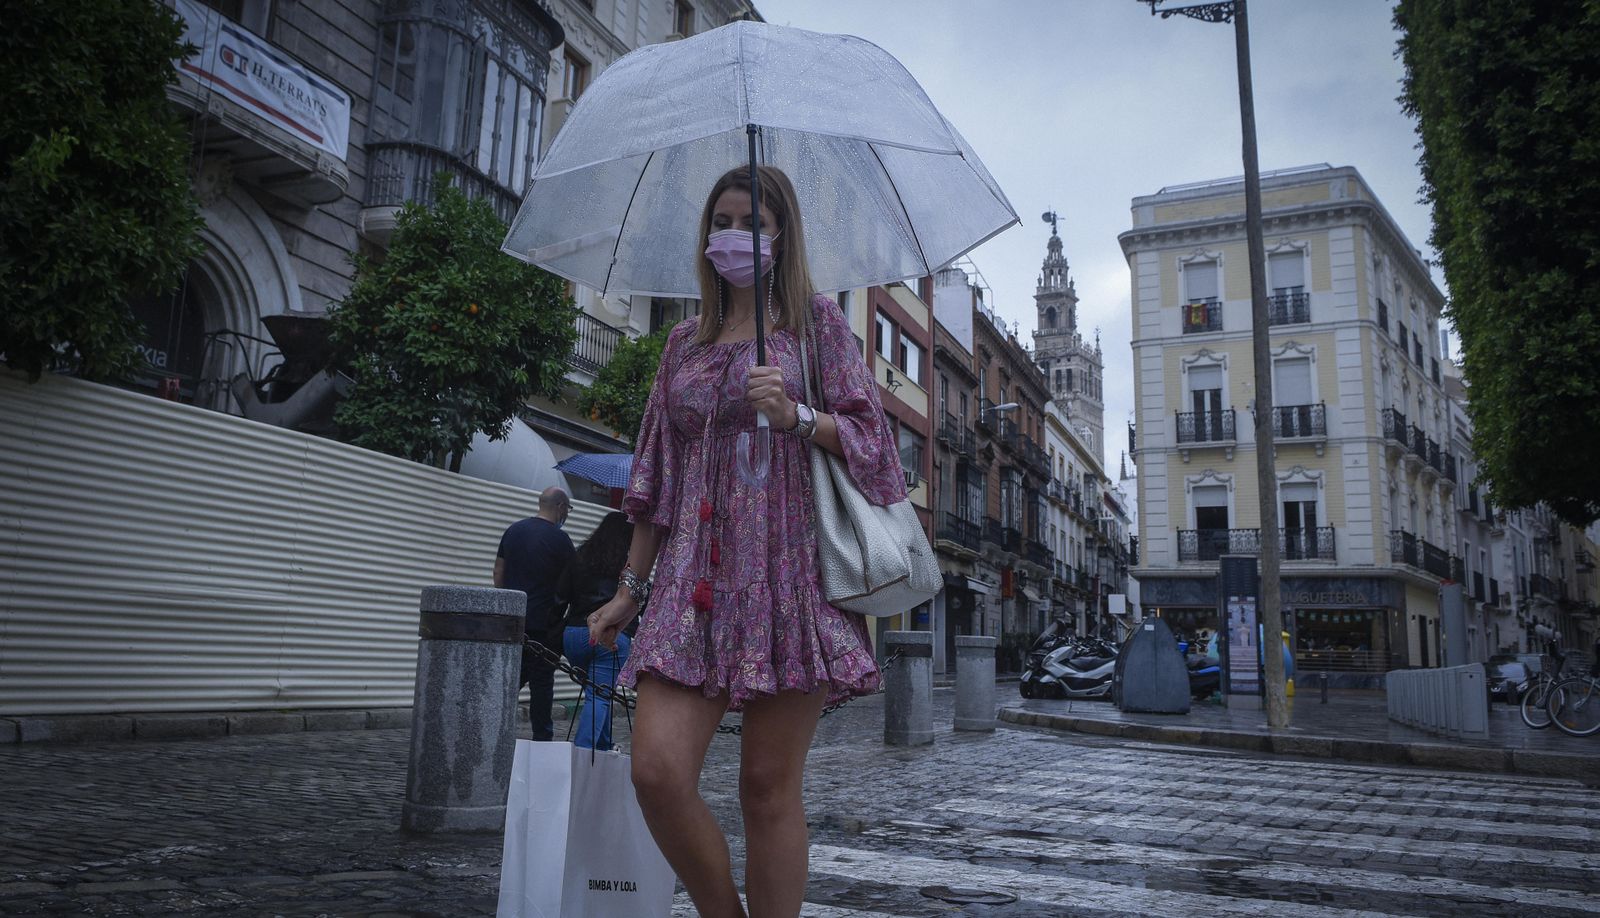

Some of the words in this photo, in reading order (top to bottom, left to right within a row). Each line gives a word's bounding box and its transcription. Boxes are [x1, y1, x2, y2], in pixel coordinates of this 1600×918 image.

[588, 879, 612, 891] BIMBA
[613, 880, 619, 891] Y
[620, 881, 637, 892] LOLA
